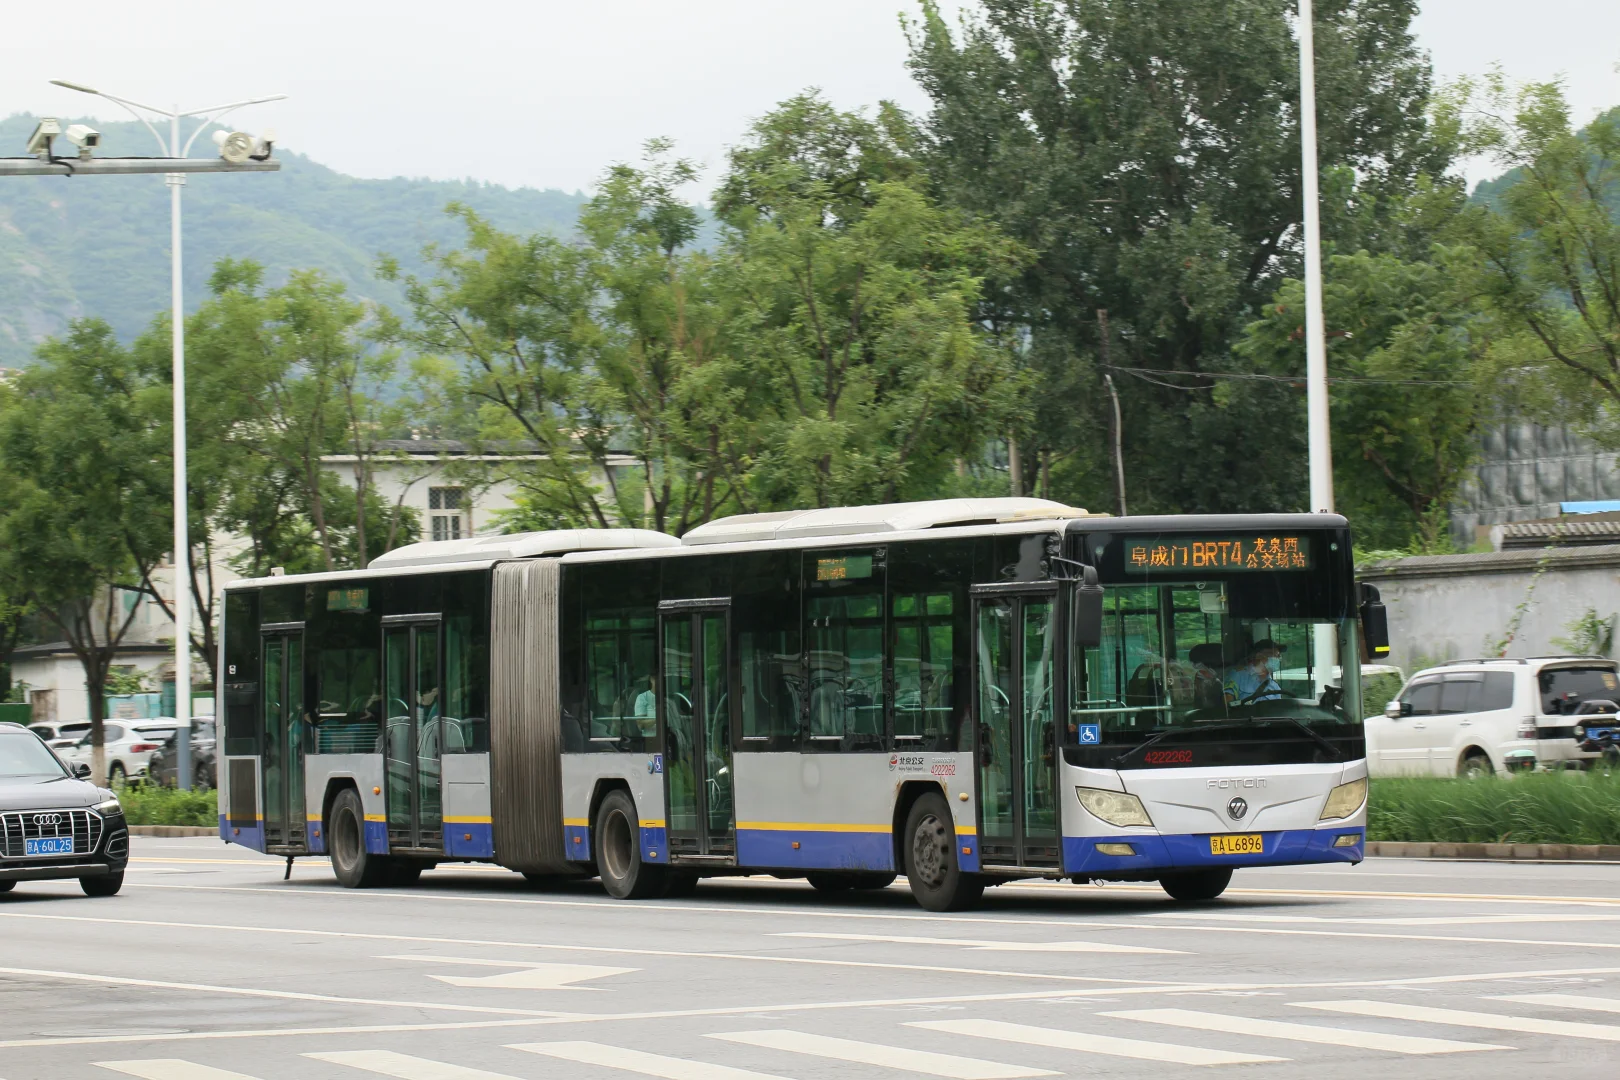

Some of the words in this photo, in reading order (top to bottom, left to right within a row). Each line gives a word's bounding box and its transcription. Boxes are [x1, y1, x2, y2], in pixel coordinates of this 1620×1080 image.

[1253, 537, 1298, 553] 龙泉西
[1130, 545, 1188, 567] 阜成门
[1192, 541, 1242, 567] BRT4
[1245, 552, 1306, 569] 公交场站
[899, 757, 924, 765] 北京公交
[1145, 751, 1192, 763] 4222262
[1206, 777, 1267, 789] FOTON
